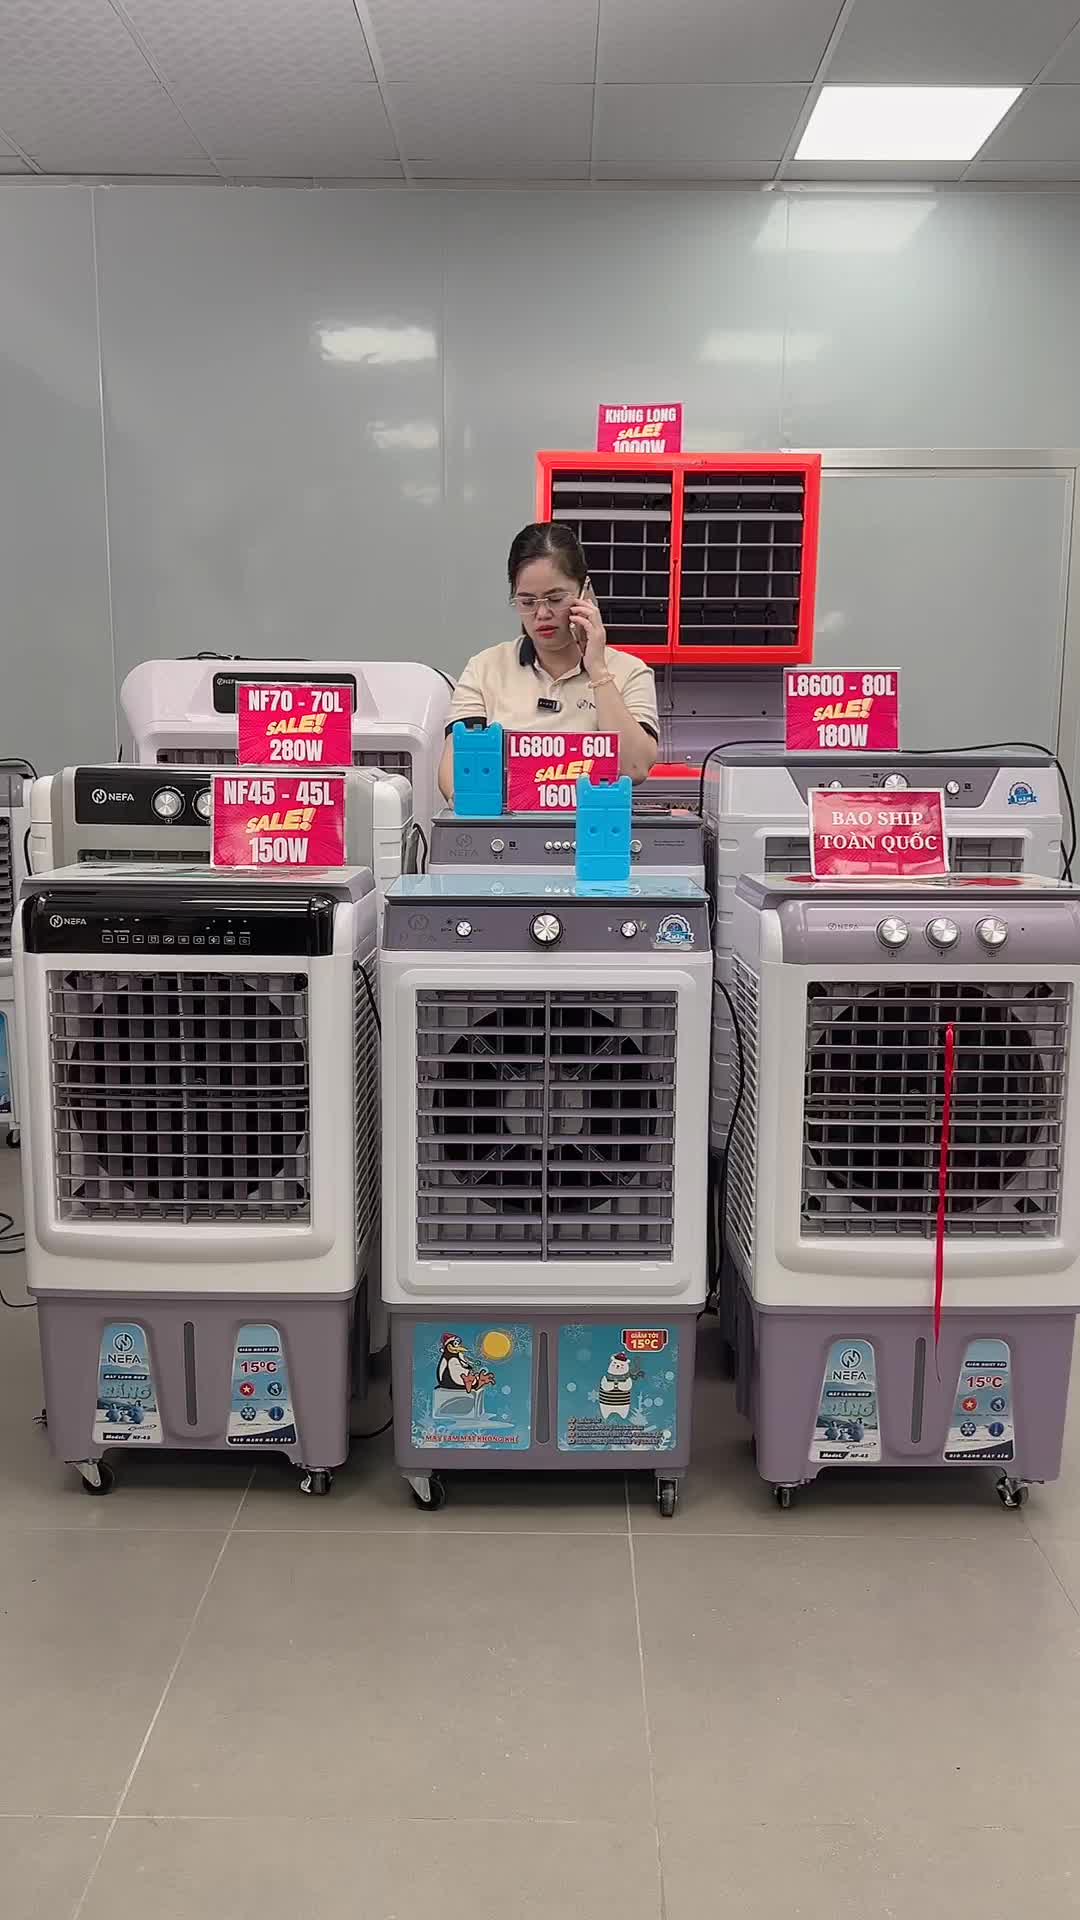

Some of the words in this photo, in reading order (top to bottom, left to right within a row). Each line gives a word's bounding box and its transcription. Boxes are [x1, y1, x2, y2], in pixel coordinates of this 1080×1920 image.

[605, 405, 644, 423] KHỦNG
[646, 407, 677, 422] LONG
[616, 422, 664, 440] SALE!
[612, 439, 666, 453] 1000W
[788, 674, 844, 697] L8600
[862, 674, 895, 697] 80L
[248, 690, 293, 712] NF70
[311, 691, 344, 713] 70L
[812, 697, 874, 722] SALE!
[265, 713, 327, 736] SALE!
[817, 723, 869, 747] 180W
[269, 738, 323, 762] 280W
[510, 735, 566, 757] L6800
[582, 735, 615, 758] 60L
[534, 759, 595, 783] SALE!
[108, 792, 135, 802] NEFA
[223, 780, 276, 805] NF45
[296, 781, 335, 806] 45L
[245, 807, 316, 834] SALE!
[832, 811, 873, 826] BAO
[878, 811, 924, 826] SHIP
[249, 837, 309, 863] 150W
[820, 831, 876, 849] TOÀN
[881, 831, 938, 854] QUỐC
[63, 917, 87, 925] NEFA
[107, 1354, 142, 1364] NEFA
[832, 1370, 867, 1381] NEFA
